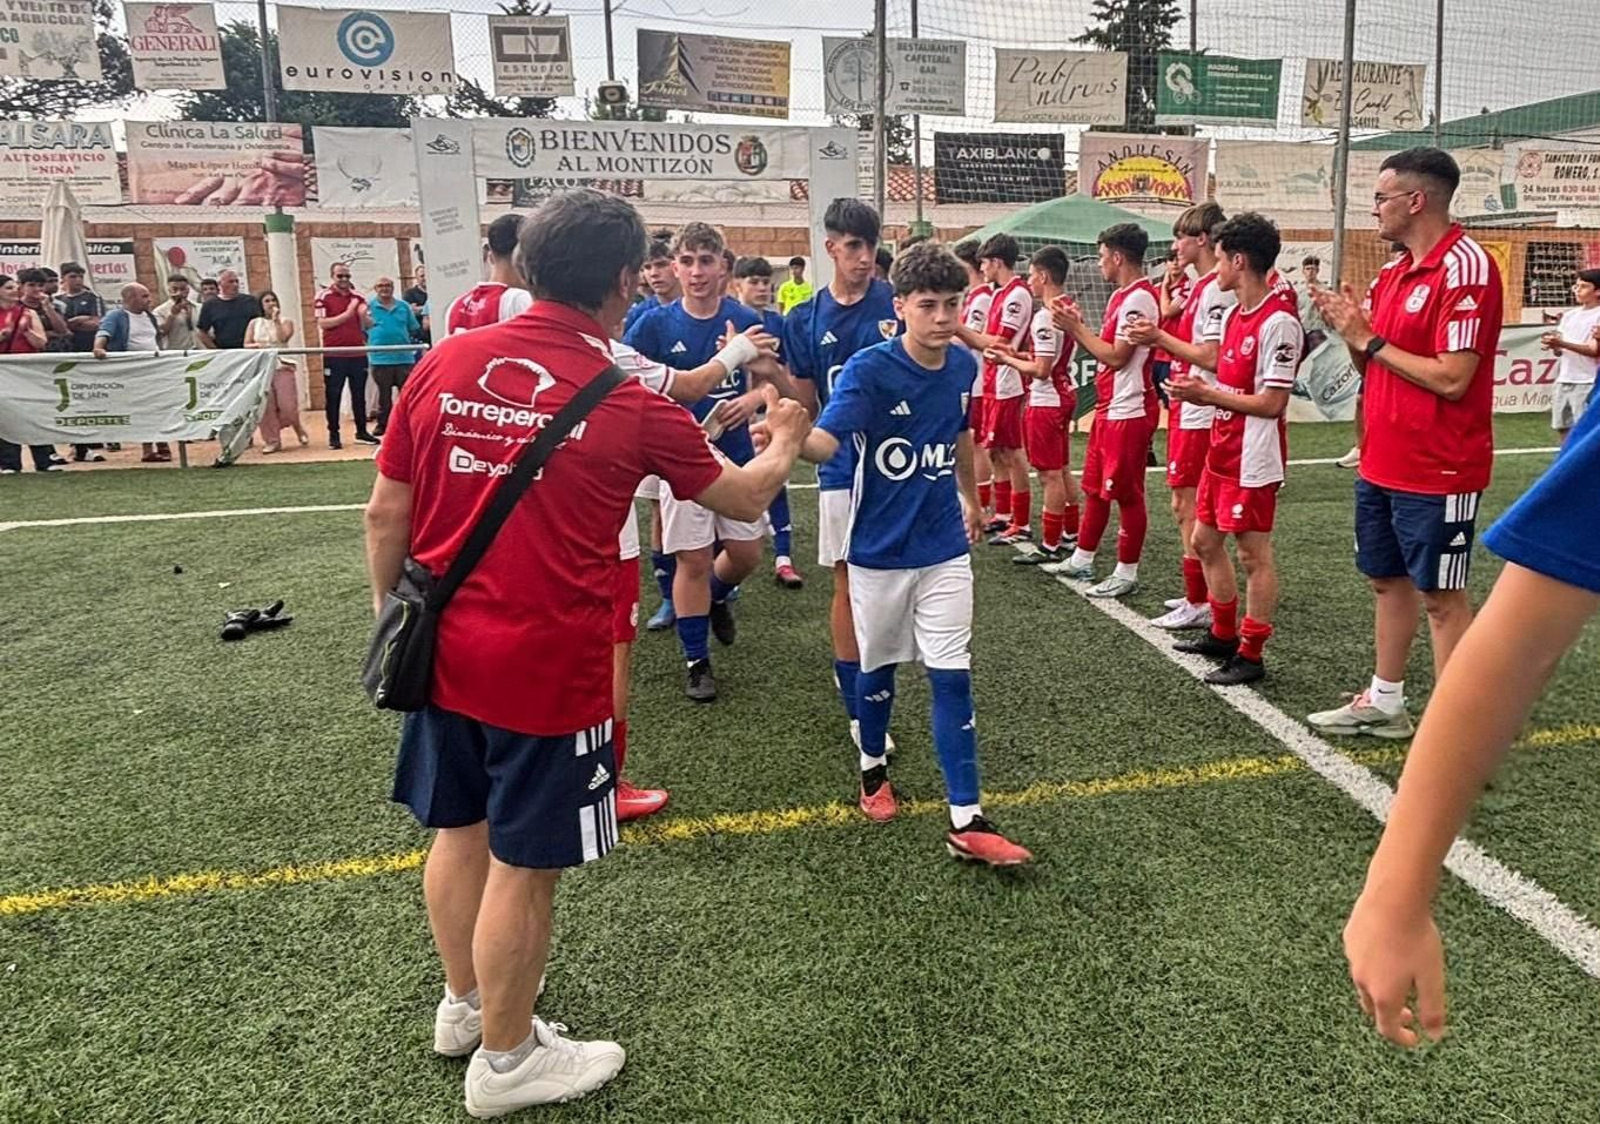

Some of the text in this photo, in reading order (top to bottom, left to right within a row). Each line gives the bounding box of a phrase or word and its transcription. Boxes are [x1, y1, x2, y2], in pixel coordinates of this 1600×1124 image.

[131, 36, 217, 52] GENERALI
[897, 42, 959, 55] RESTAURANTE
[286, 66, 452, 83] eurovision
[503, 64, 563, 73] ESTUDIO
[919, 66, 937, 74] BAR
[1009, 56, 1066, 86] Pub
[1329, 61, 1403, 85] REAURANTE
[146, 125, 282, 140] Clínica La Salud
[540, 129, 732, 155] BIENVENIDOS
[3, 153, 106, 162] AUTOSERVICIO
[556, 155, 714, 175] AL MONTIZÓN
[1523, 185, 1533, 193] 24
[71, 382, 124, 391] DIPUTACIÓN
[73, 392, 84, 400] DE
[54, 416, 131, 426] DEPORTES
[438, 393, 587, 440] Torreperoil
